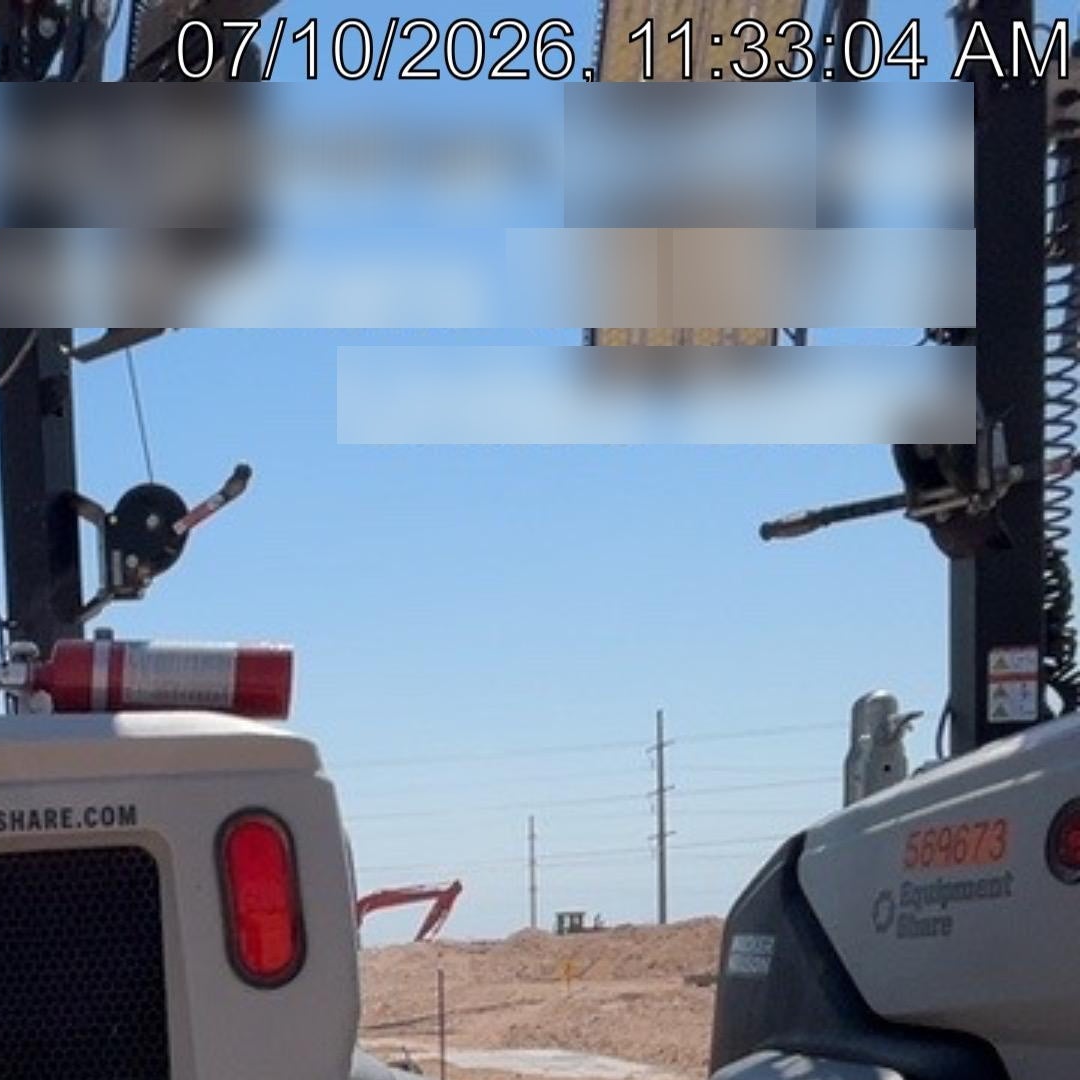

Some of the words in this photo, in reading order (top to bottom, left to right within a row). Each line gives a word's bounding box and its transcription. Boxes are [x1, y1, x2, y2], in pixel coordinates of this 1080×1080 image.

[903, 817, 1009, 868] 569673
[899, 870, 1015, 911] Equipment
[896, 911, 953, 939] Share
